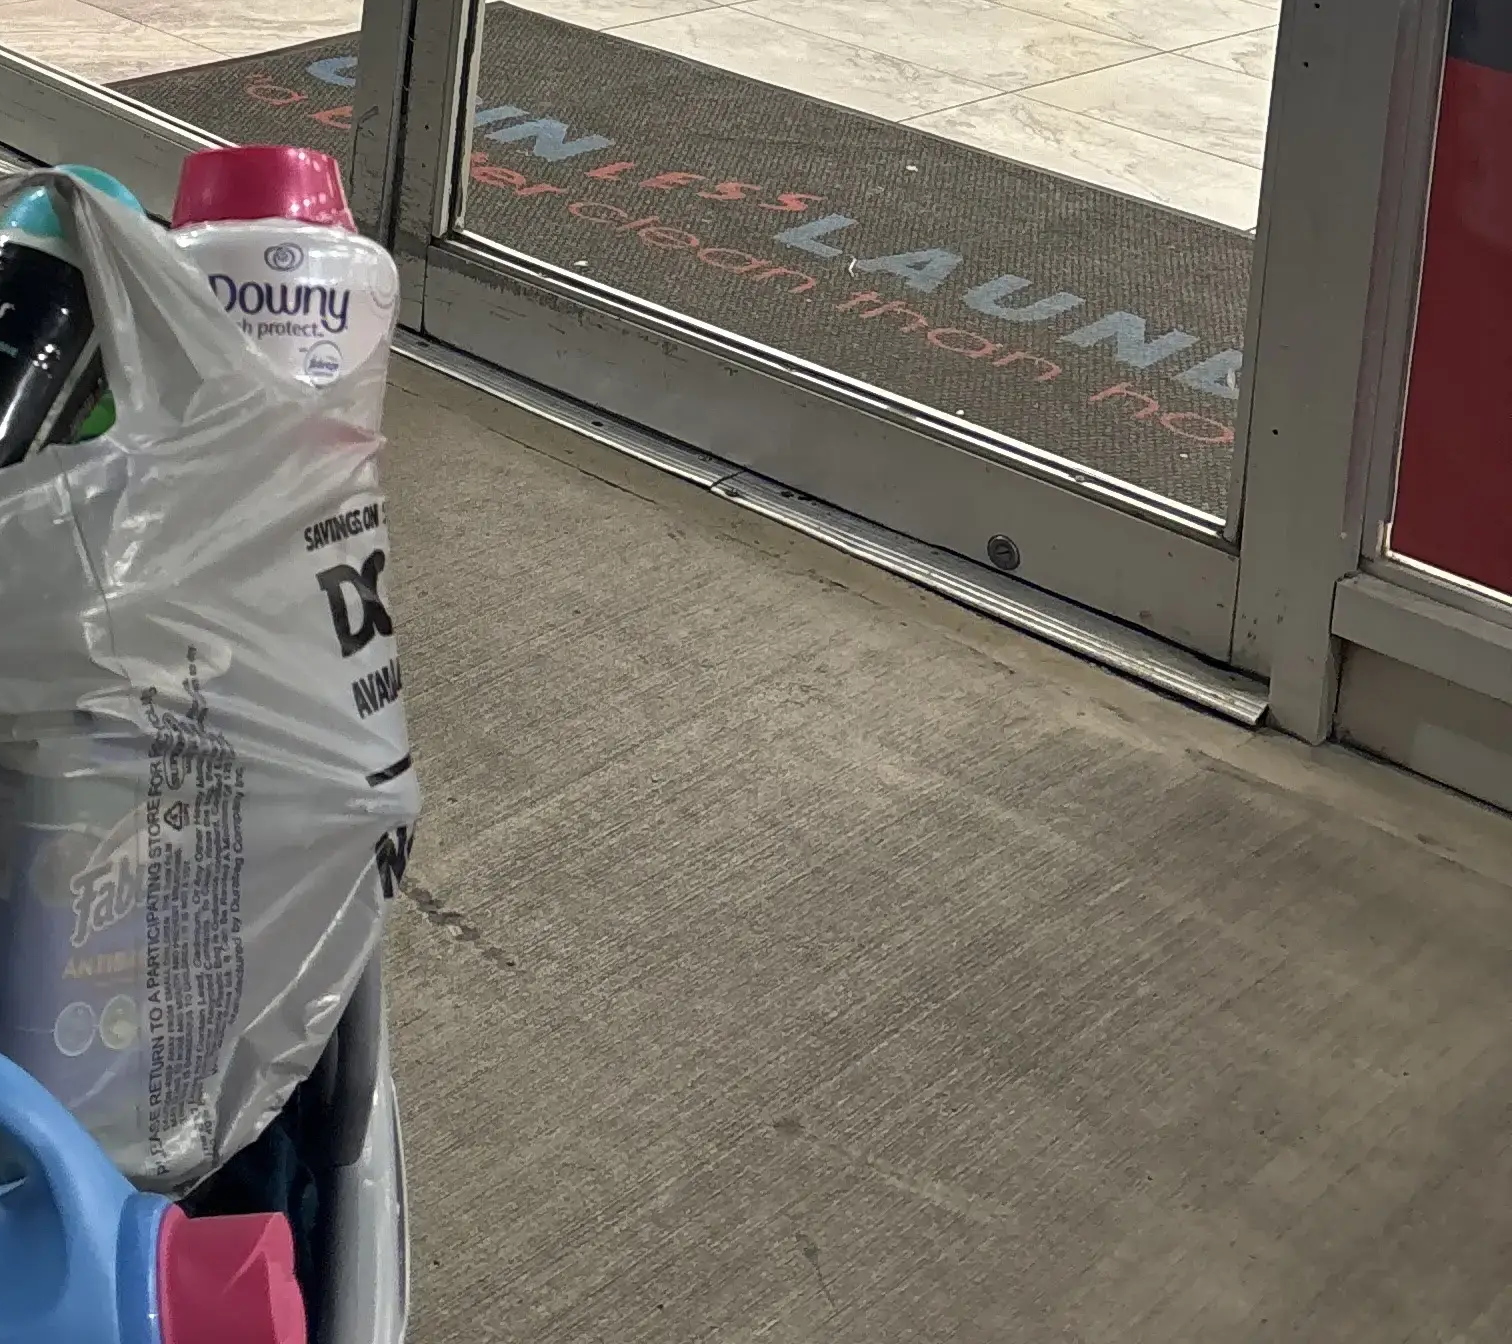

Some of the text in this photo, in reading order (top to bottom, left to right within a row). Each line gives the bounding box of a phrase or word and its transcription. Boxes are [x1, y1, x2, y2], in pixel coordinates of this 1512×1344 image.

[303, 502, 381, 553] SAVINGS ON
[146, 760, 164, 798] FOR
[146, 798, 163, 860] STORE
[145, 861, 162, 991] PARTICIPATING
[146, 990, 162, 1004] A
[149, 1006, 164, 1034] TO
[148, 1036, 166, 1107] RETURN
